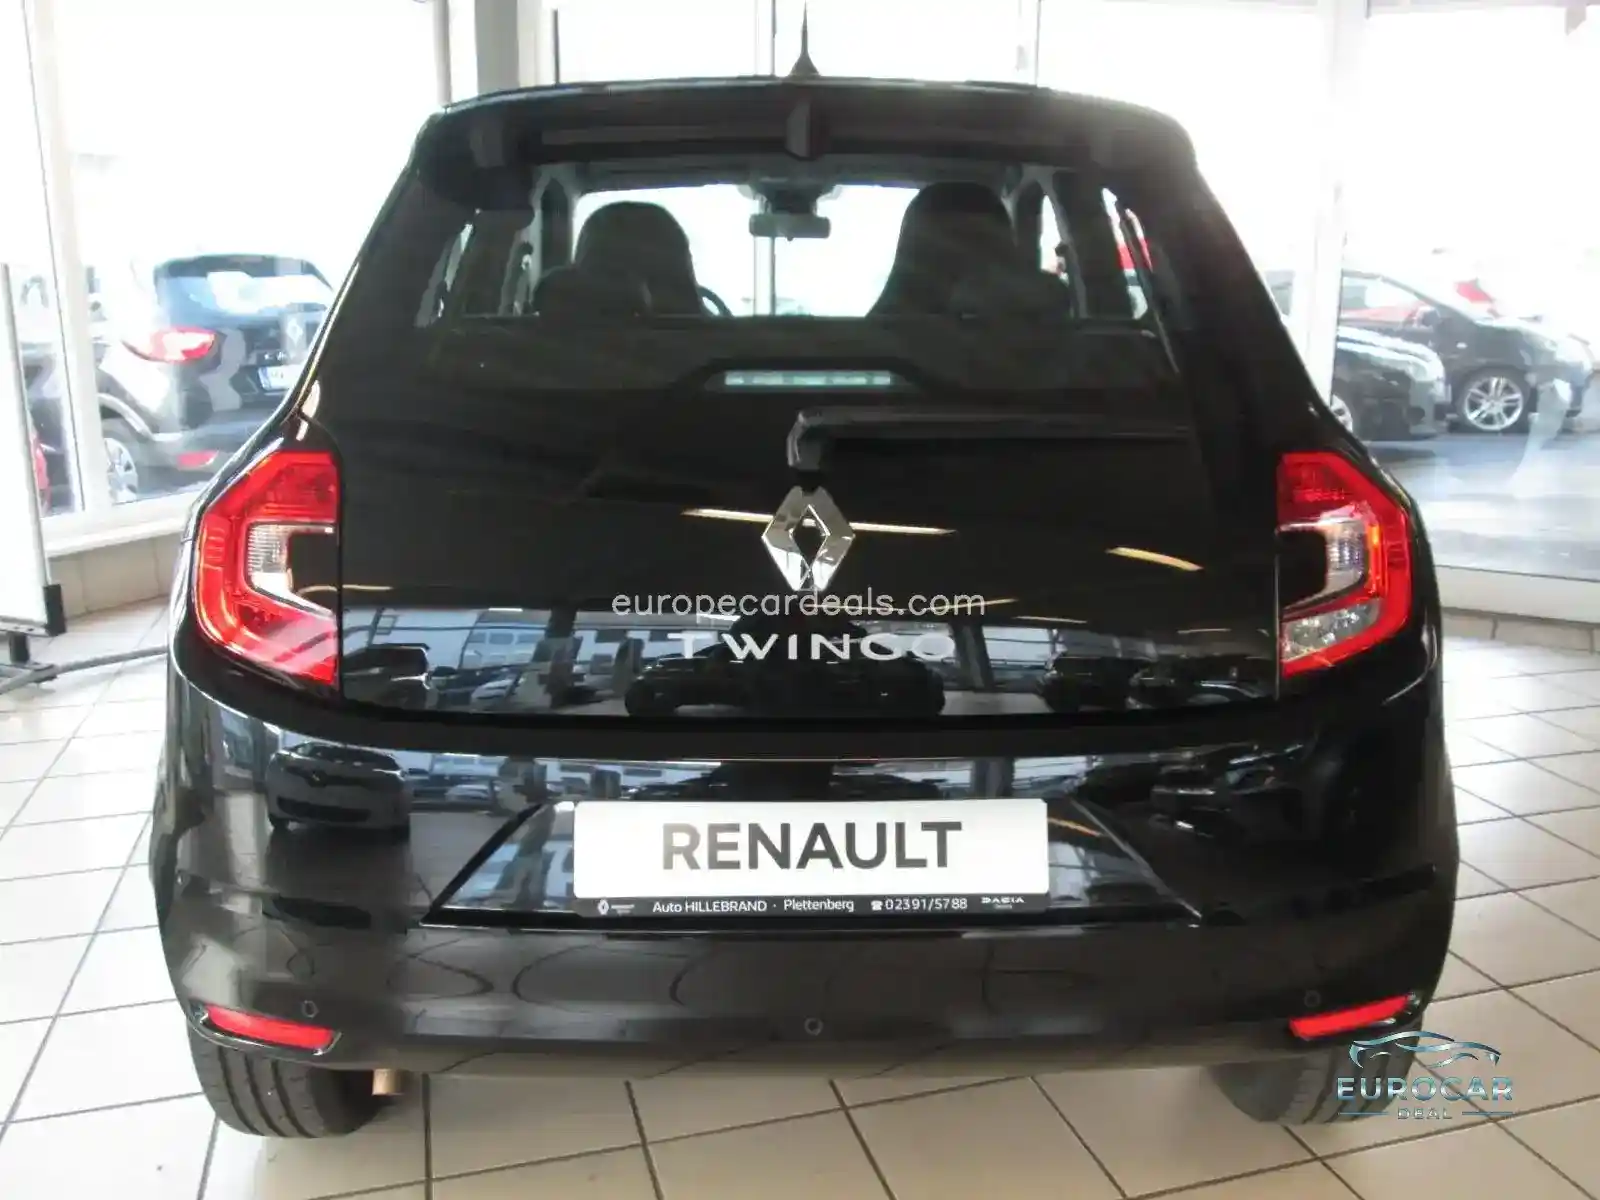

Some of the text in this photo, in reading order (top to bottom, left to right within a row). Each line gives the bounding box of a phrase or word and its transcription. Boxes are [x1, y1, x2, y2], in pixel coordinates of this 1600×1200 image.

[667, 632, 956, 661] TWINGO
[662, 821, 962, 869] RENAULT
[652, 898, 968, 913] Auto HILLEBRAND Plettenberg 02391/5788
